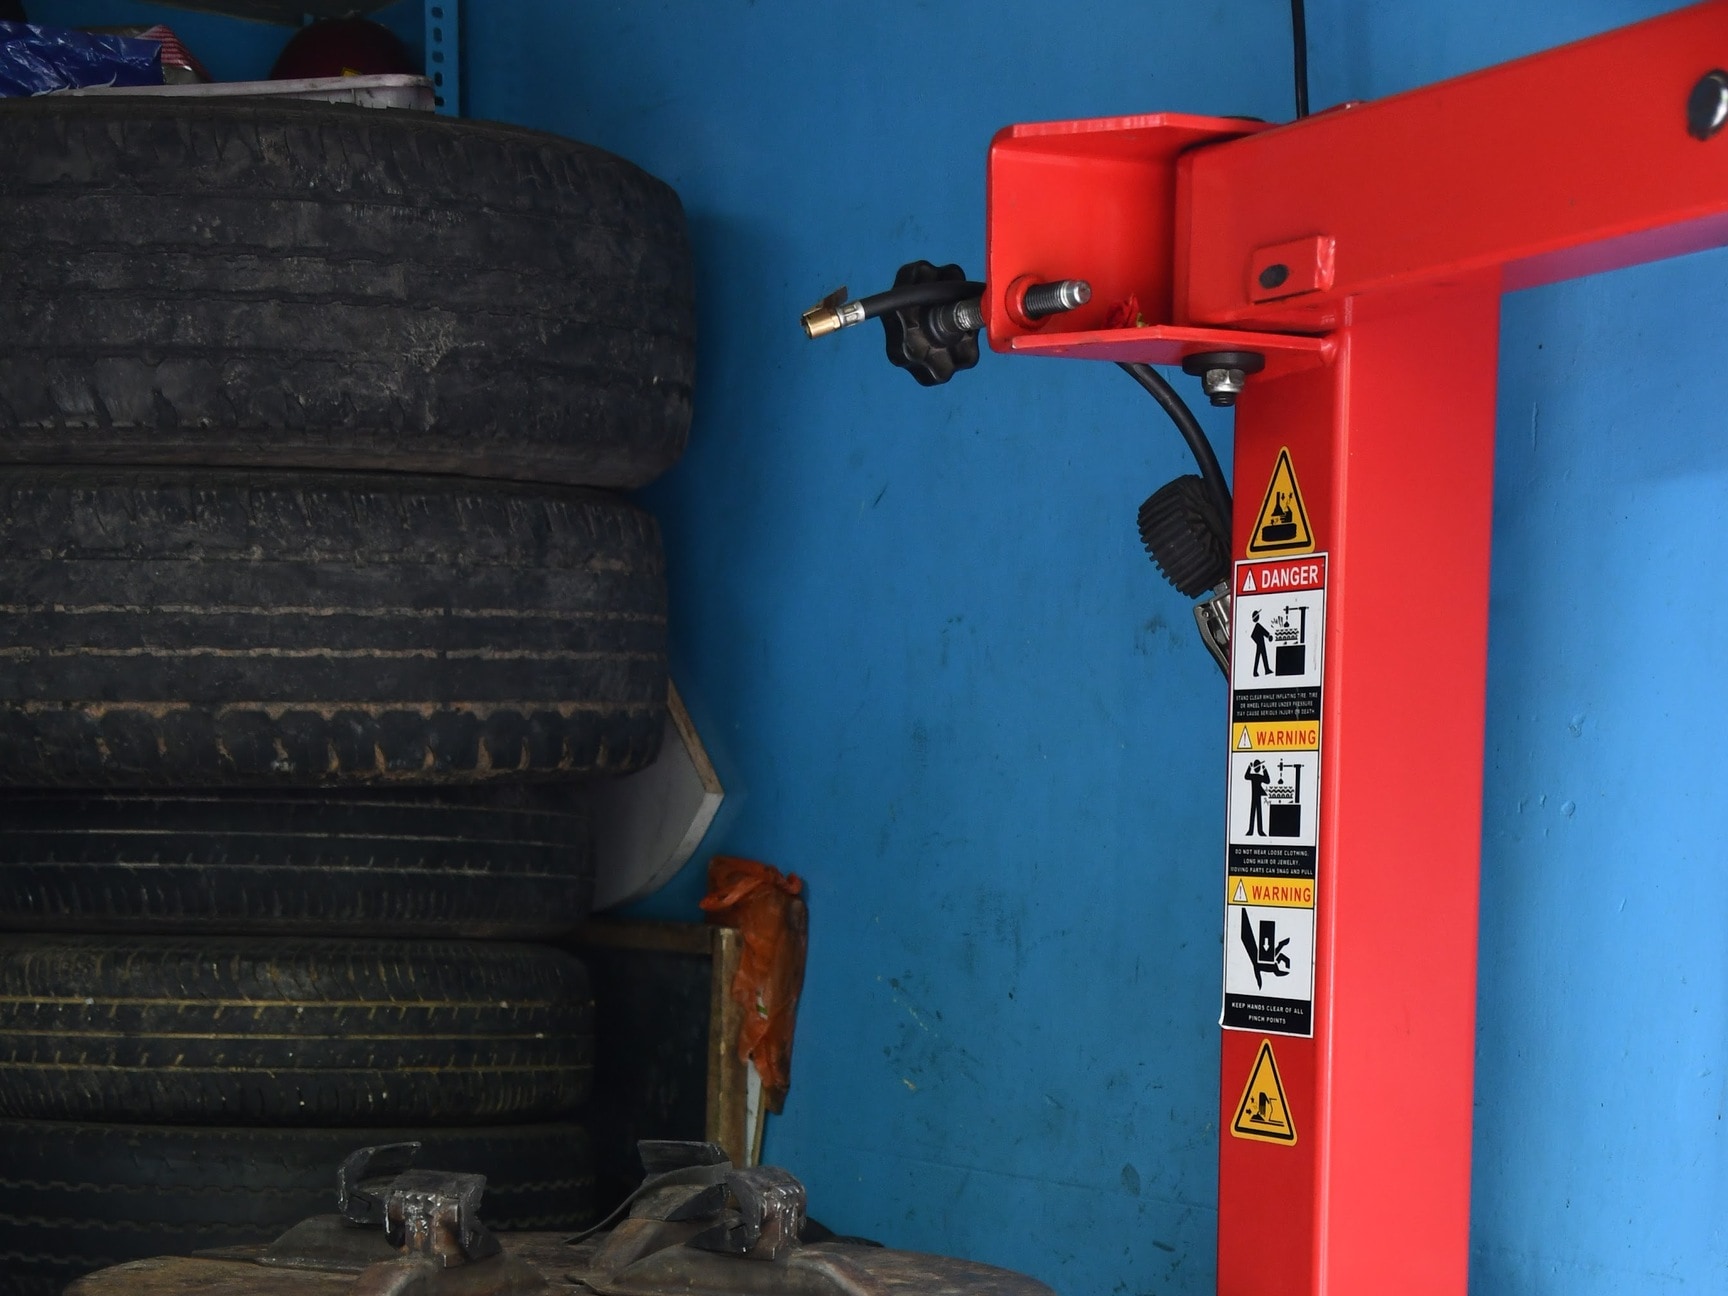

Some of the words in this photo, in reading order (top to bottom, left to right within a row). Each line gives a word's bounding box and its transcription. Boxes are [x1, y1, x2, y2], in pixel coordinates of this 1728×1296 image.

[1261, 565, 1318, 588] DANGER
[1257, 730, 1316, 745] WARNING
[1252, 886, 1311, 902] WARNING
